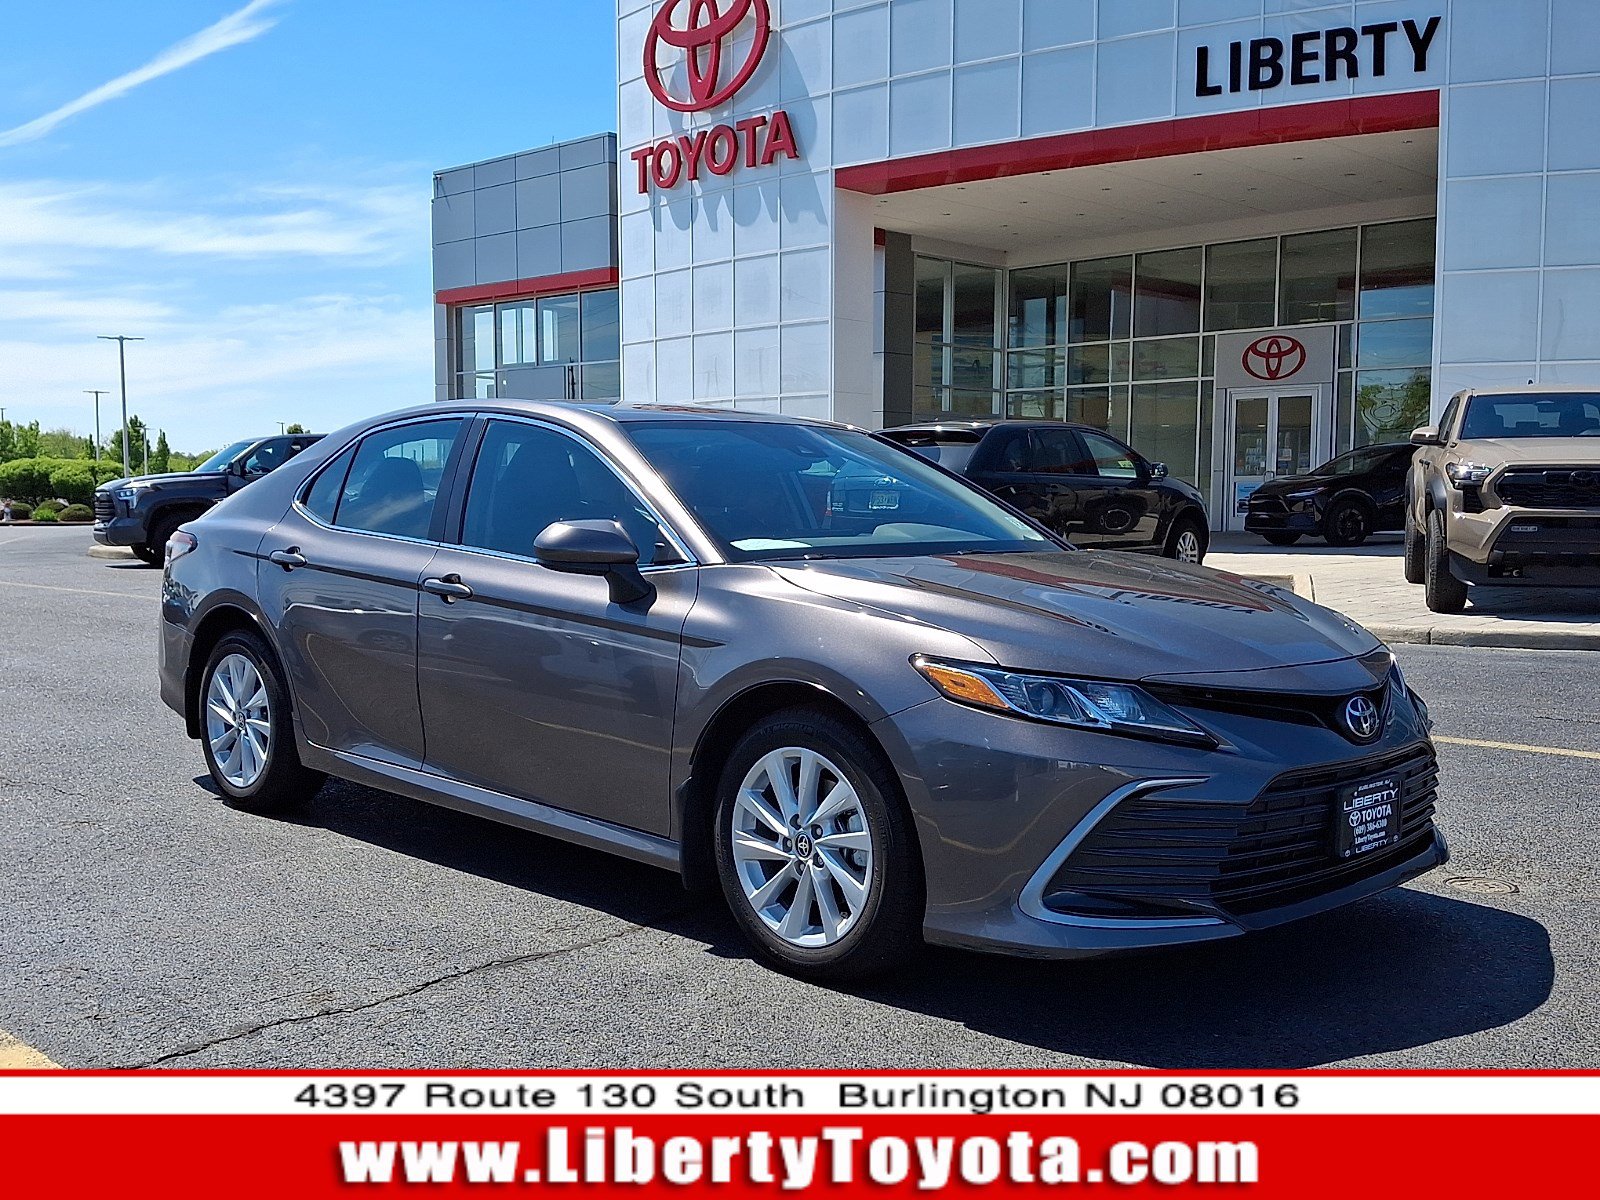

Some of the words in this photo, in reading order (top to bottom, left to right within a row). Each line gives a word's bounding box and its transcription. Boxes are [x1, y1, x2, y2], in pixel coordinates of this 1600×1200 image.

[1195, 16, 1442, 97] LIBERTY
[631, 110, 799, 194] TOYOTA
[1343, 788, 1399, 811] LIBERTY
[1361, 803, 1392, 822] TOYOTA
[1355, 838, 1389, 854] LIBERTY
